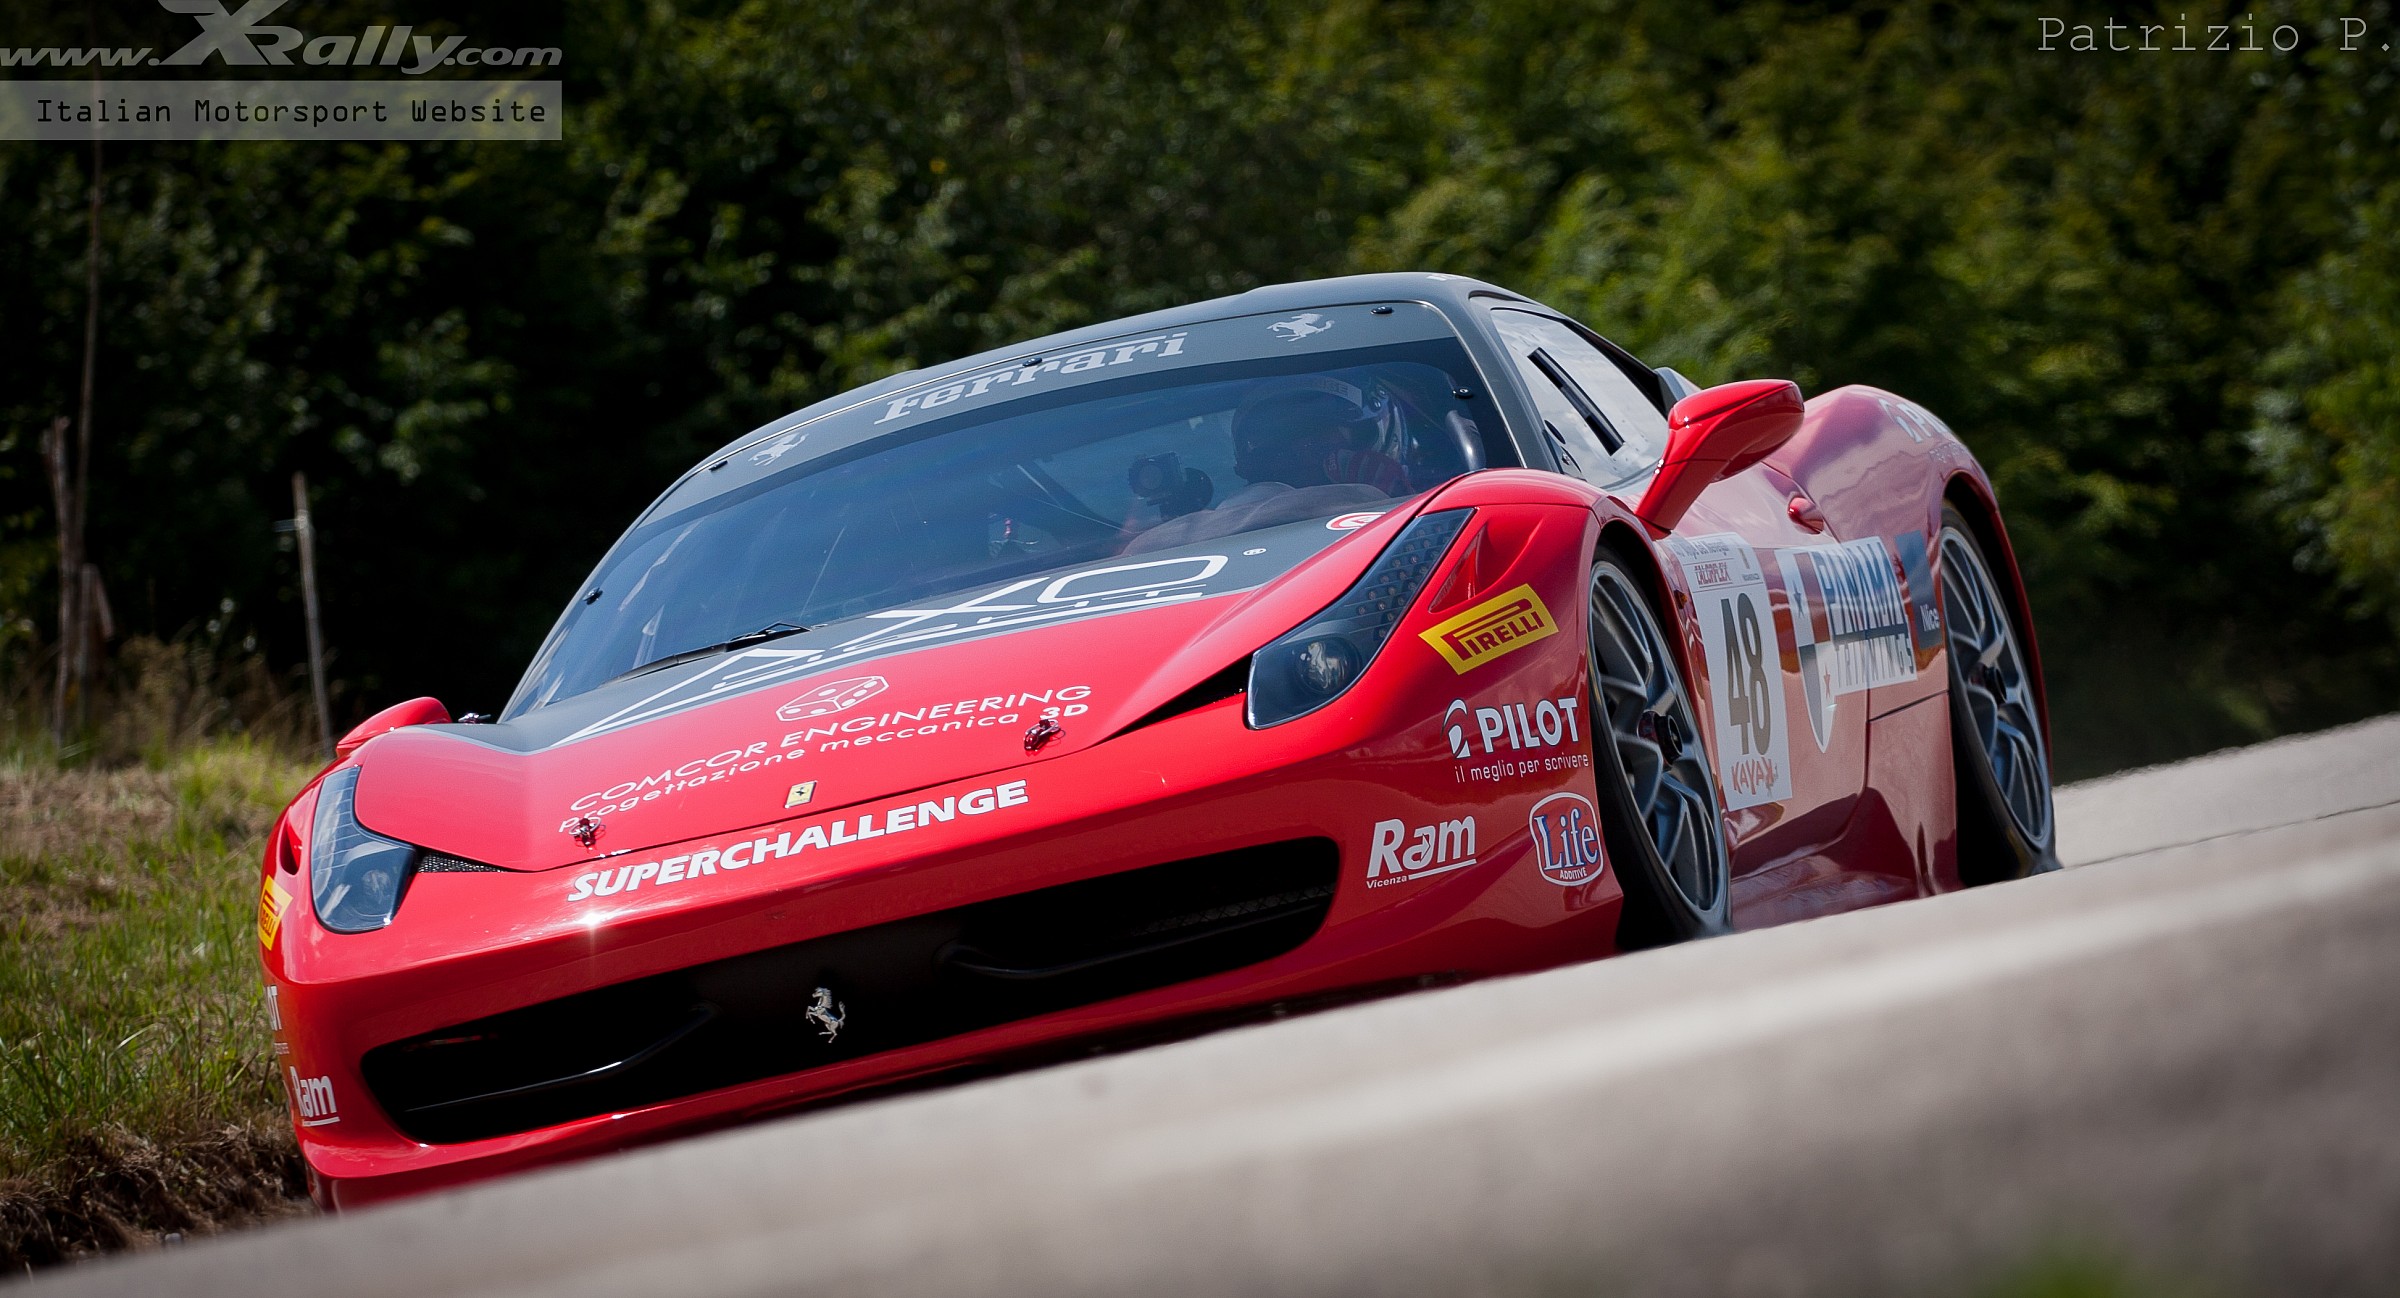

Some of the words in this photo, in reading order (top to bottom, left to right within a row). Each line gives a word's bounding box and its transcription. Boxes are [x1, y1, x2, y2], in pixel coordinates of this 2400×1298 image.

[873, 331, 1188, 426] Ferrari
[1811, 541, 1908, 636] PANAMA
[1919, 603, 1941, 631] Nice
[1440, 598, 1546, 662] PIRELLI
[1720, 592, 1772, 756] 48
[569, 741, 769, 812] COMCOR
[780, 684, 1092, 748] ENGINEERING
[1475, 697, 1579, 754] PILOT
[558, 748, 806, 833] progettazione
[819, 712, 1019, 753] meccanica
[1039, 703, 1089, 720] 3D
[1454, 766, 1466, 783] il
[1470, 759, 1514, 782] meglio
[1519, 757, 1541, 778] per
[1544, 752, 1590, 772] scrivere
[566, 779, 1029, 904] SUPERCHALLENGE
[1366, 815, 1477, 877] Ram
[1533, 807, 1599, 871] Life
[1366, 874, 1409, 889] Vicenza
